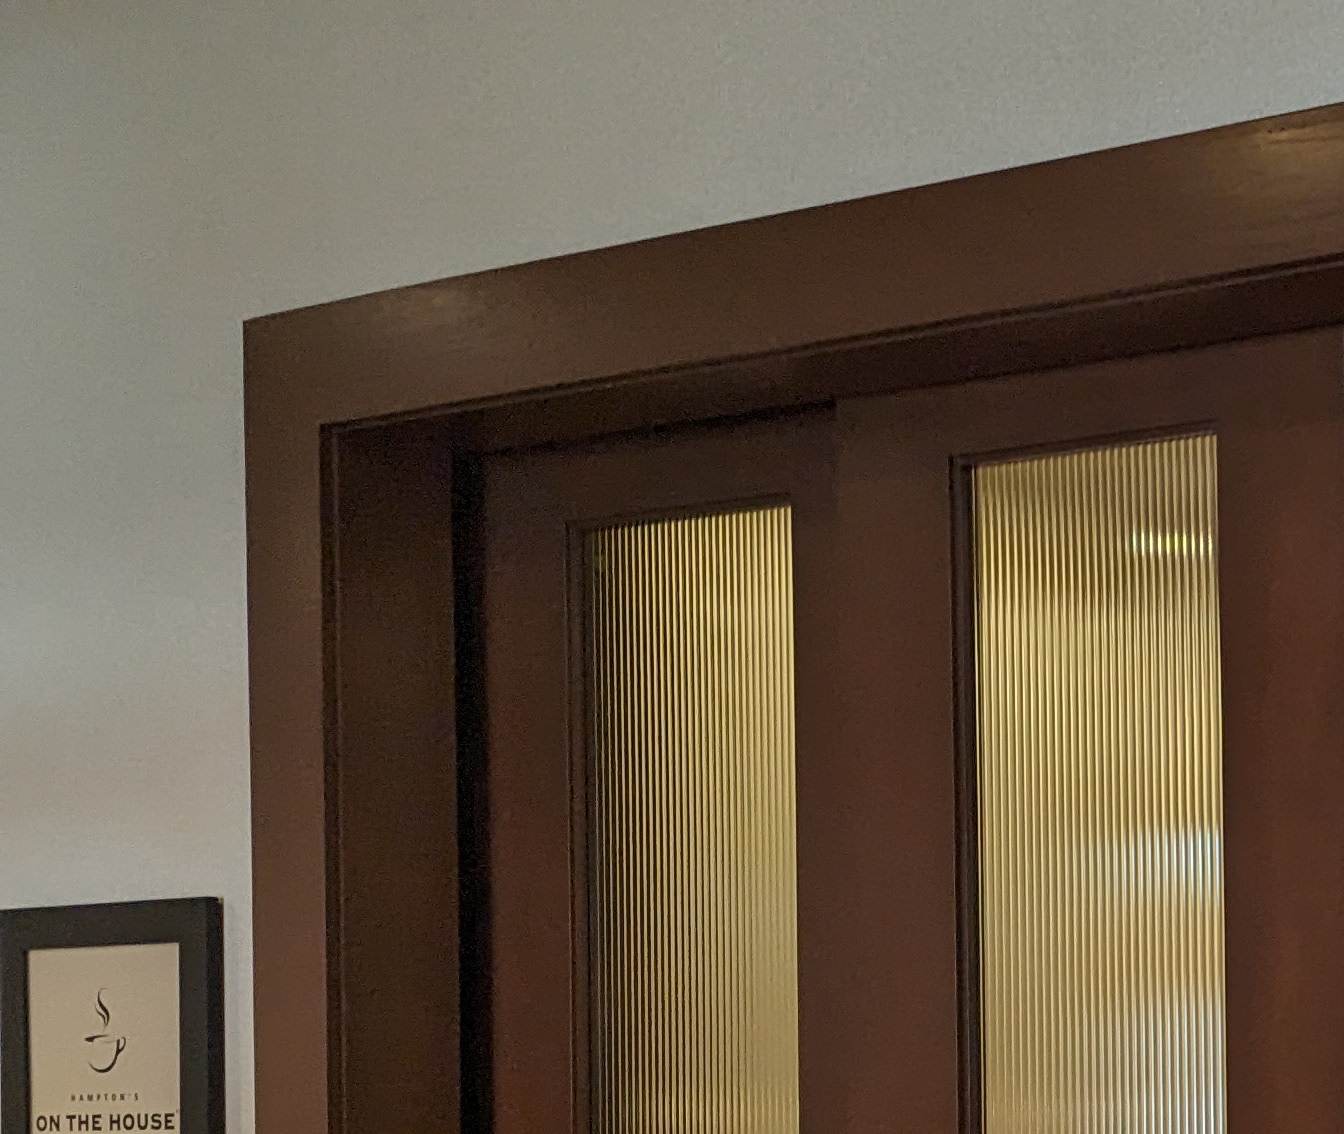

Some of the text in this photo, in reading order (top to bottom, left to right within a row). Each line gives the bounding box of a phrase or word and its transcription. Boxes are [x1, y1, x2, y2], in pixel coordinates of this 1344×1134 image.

[71, 1093, 139, 1102] HAMPTON'S
[36, 1112, 175, 1132] ON THE HOUSE
